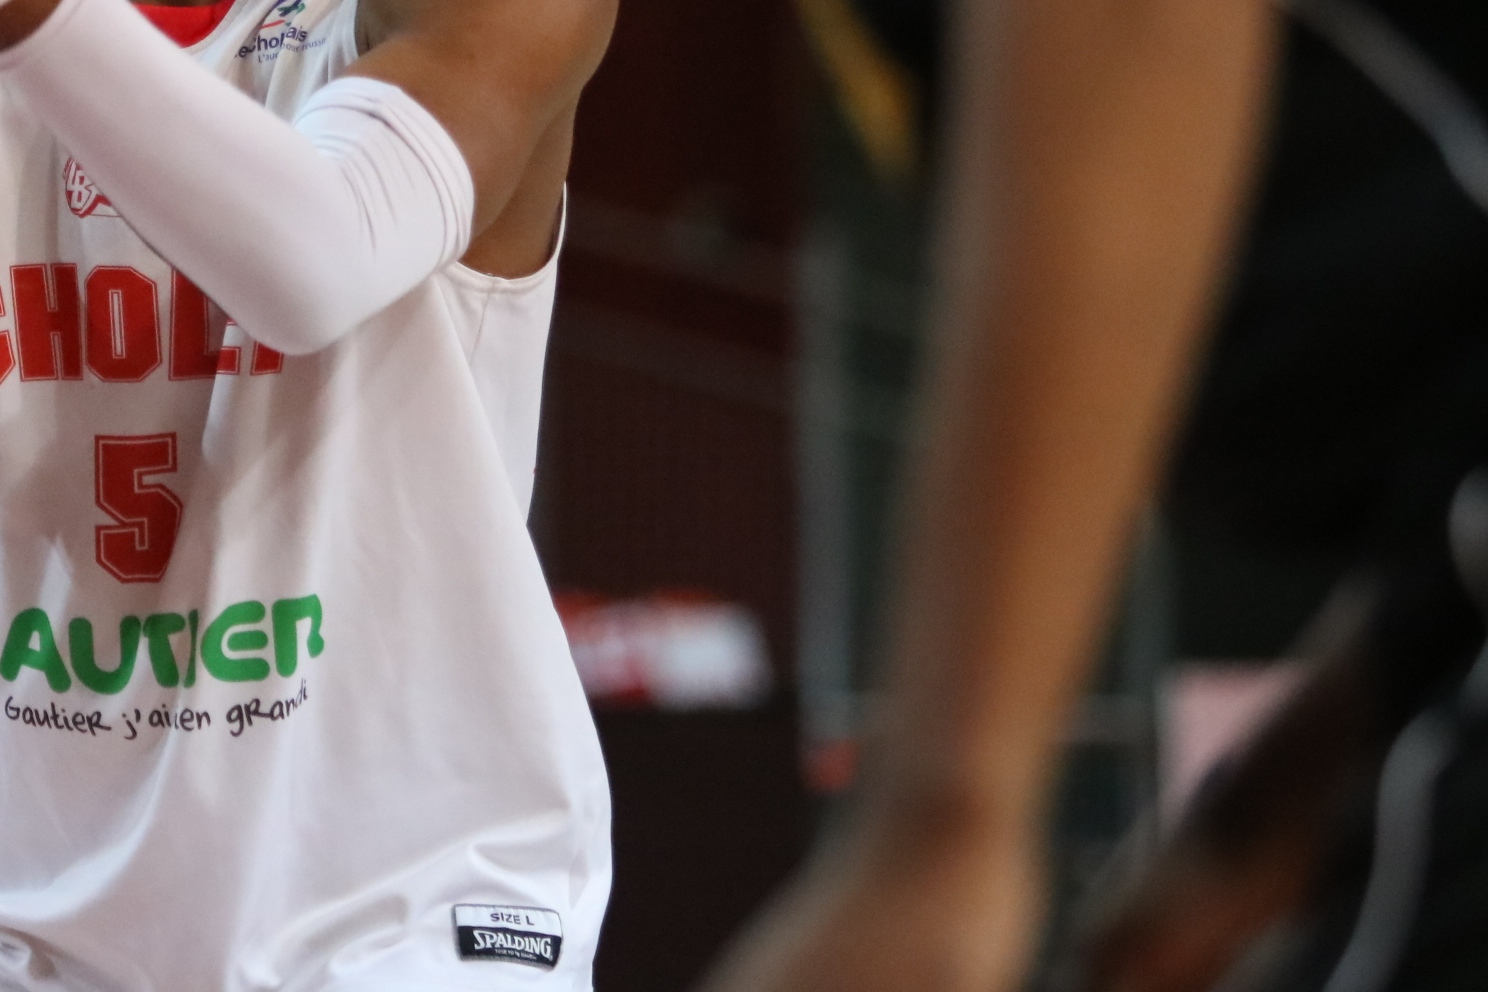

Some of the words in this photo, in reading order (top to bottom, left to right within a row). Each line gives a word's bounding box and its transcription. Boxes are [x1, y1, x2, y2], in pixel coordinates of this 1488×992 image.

[95, 432, 183, 584] 5
[490, 912, 521, 925] SIZE
[525, 915, 535, 926] L
[473, 930, 553, 961] SPALDING
